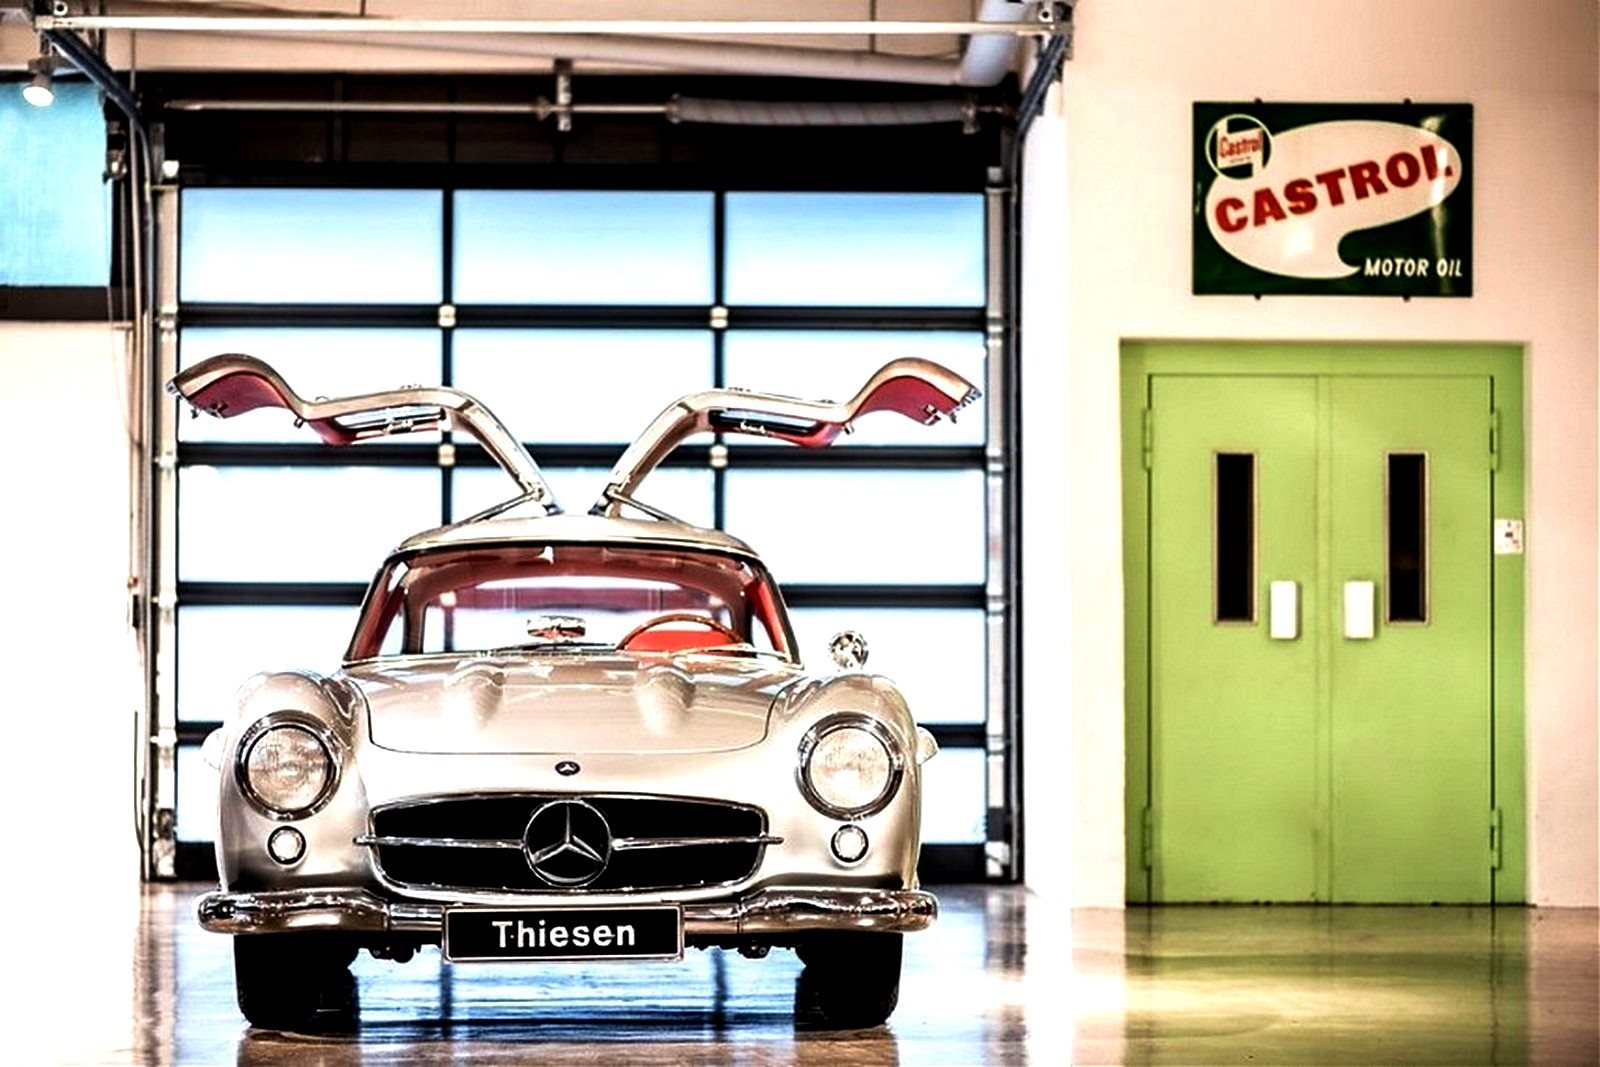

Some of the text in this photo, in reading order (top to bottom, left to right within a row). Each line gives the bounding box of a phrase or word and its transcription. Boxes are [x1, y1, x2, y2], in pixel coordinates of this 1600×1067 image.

[1215, 144, 1453, 233] CASTROL
[1364, 257, 1463, 278] MOTOR OIL
[491, 919, 635, 948] Thiesen
